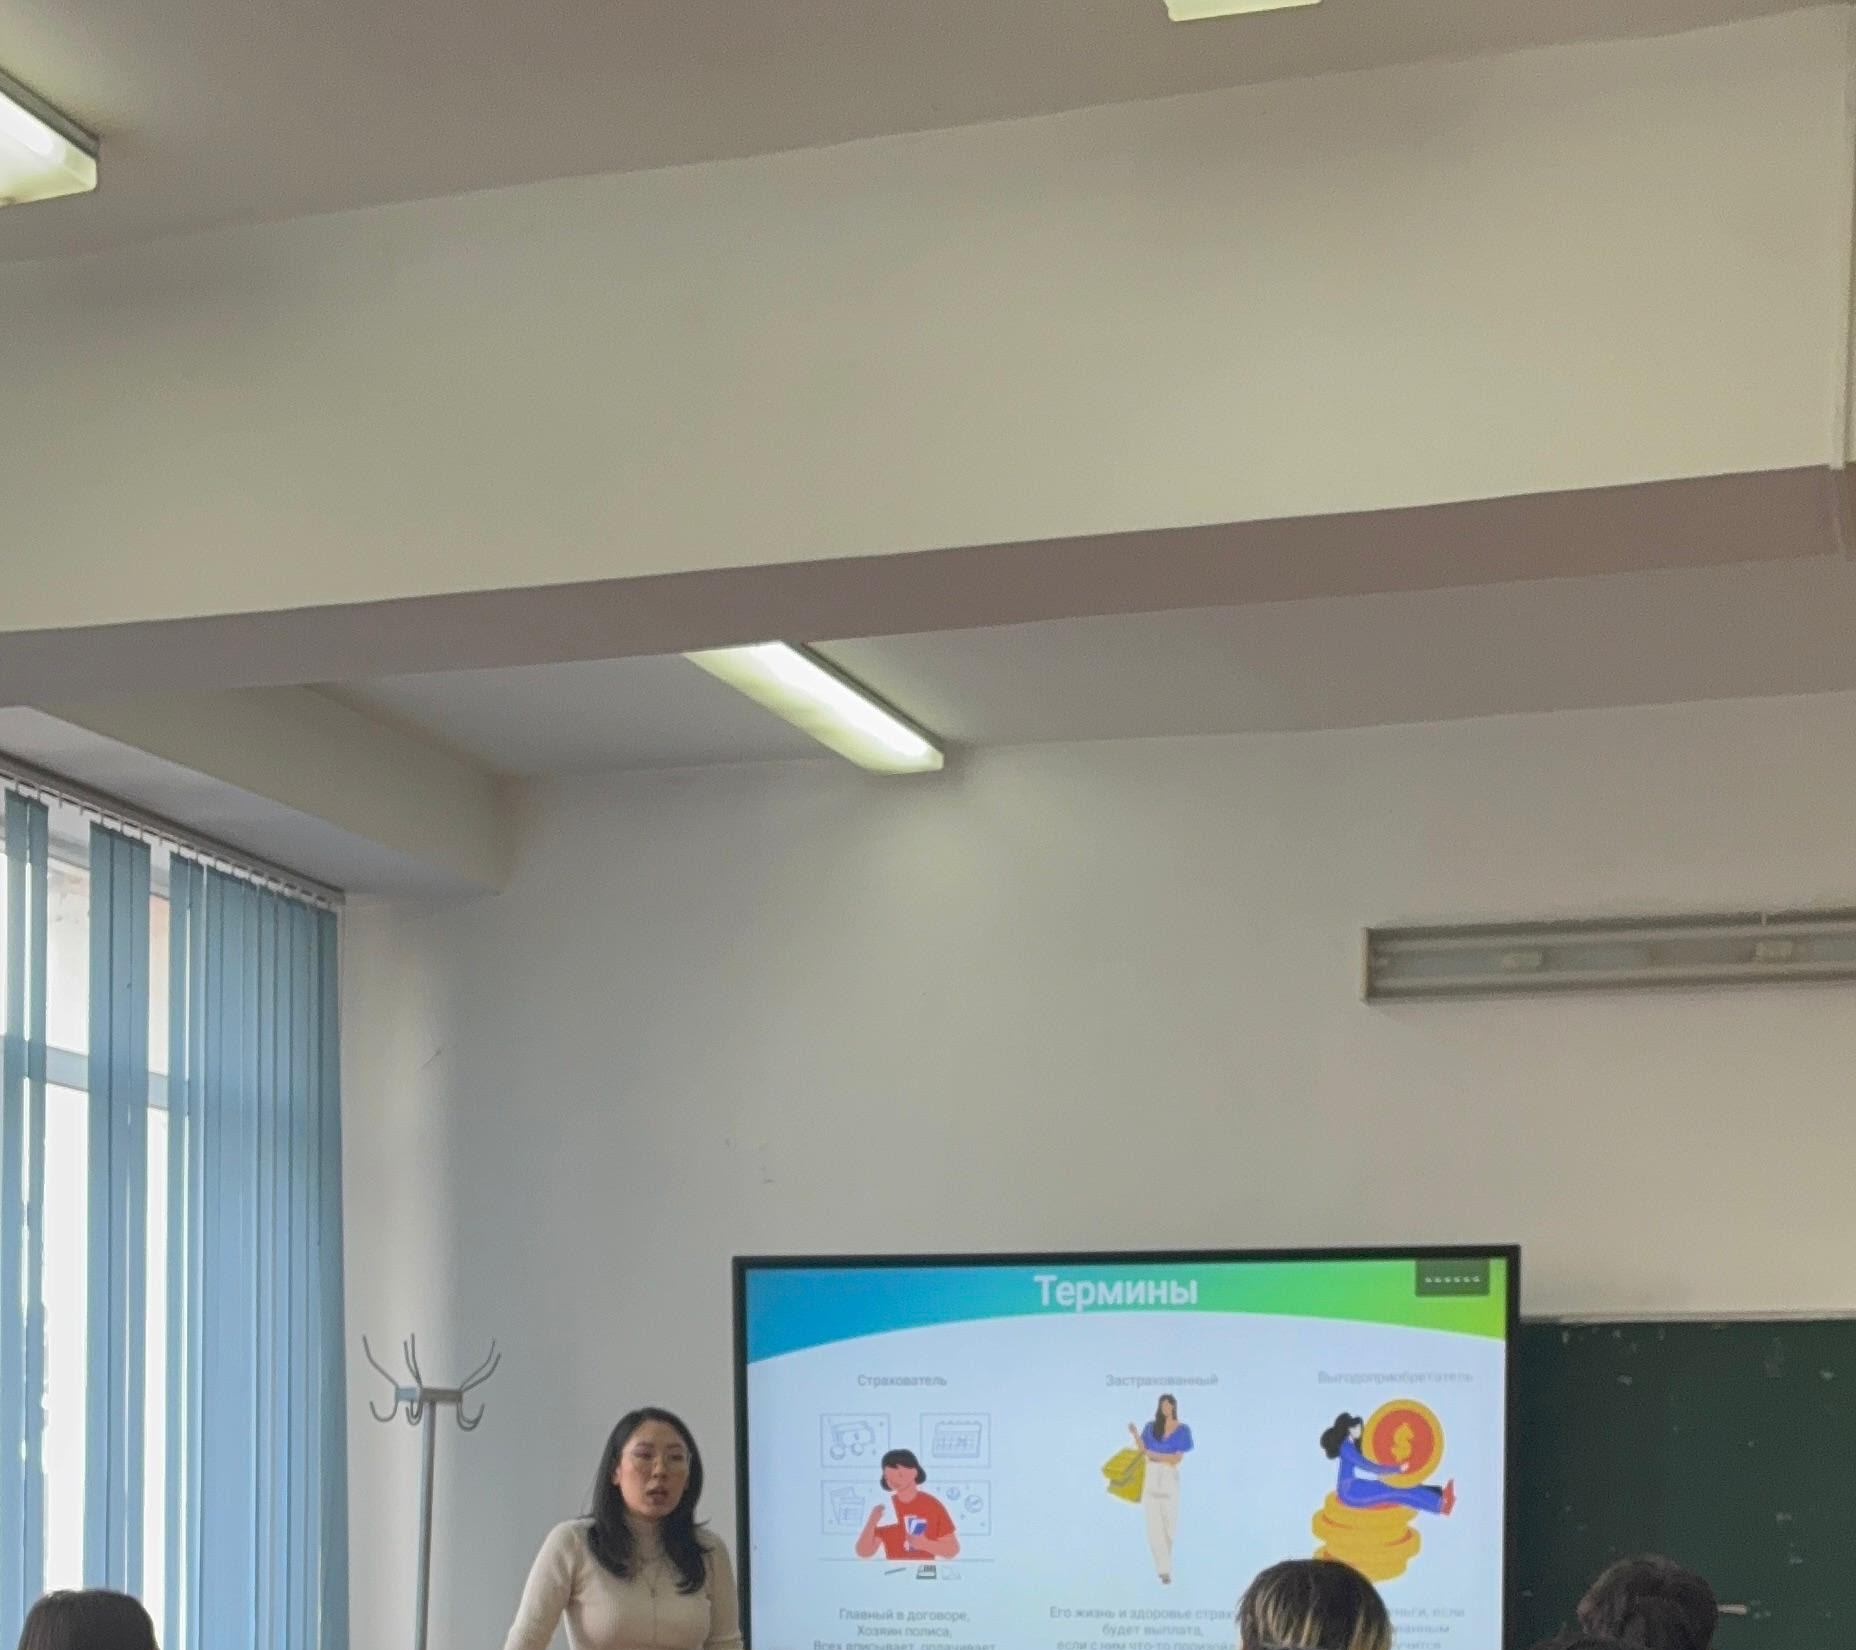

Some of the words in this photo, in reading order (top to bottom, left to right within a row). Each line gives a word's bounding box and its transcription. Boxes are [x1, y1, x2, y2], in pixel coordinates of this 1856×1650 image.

[1034, 1274, 1198, 1313] Термины
[857, 1375, 948, 1389] Страхователь
[1105, 1373, 1219, 1388] Застрахованный
[838, 1607, 894, 1621] Главный
[896, 1611, 905, 1621] в
[906, 1611, 970, 1624] договоре,
[1049, 1606, 1073, 1619] Его
[1074, 1608, 1115, 1619] жизнь
[1119, 1608, 1128, 1619] и
[1128, 1608, 1193, 1621] здоровье
[857, 1625, 902, 1637] Хозяин
[904, 1627, 953, 1639] полиса,
[1102, 1624, 1141, 1637] будет
